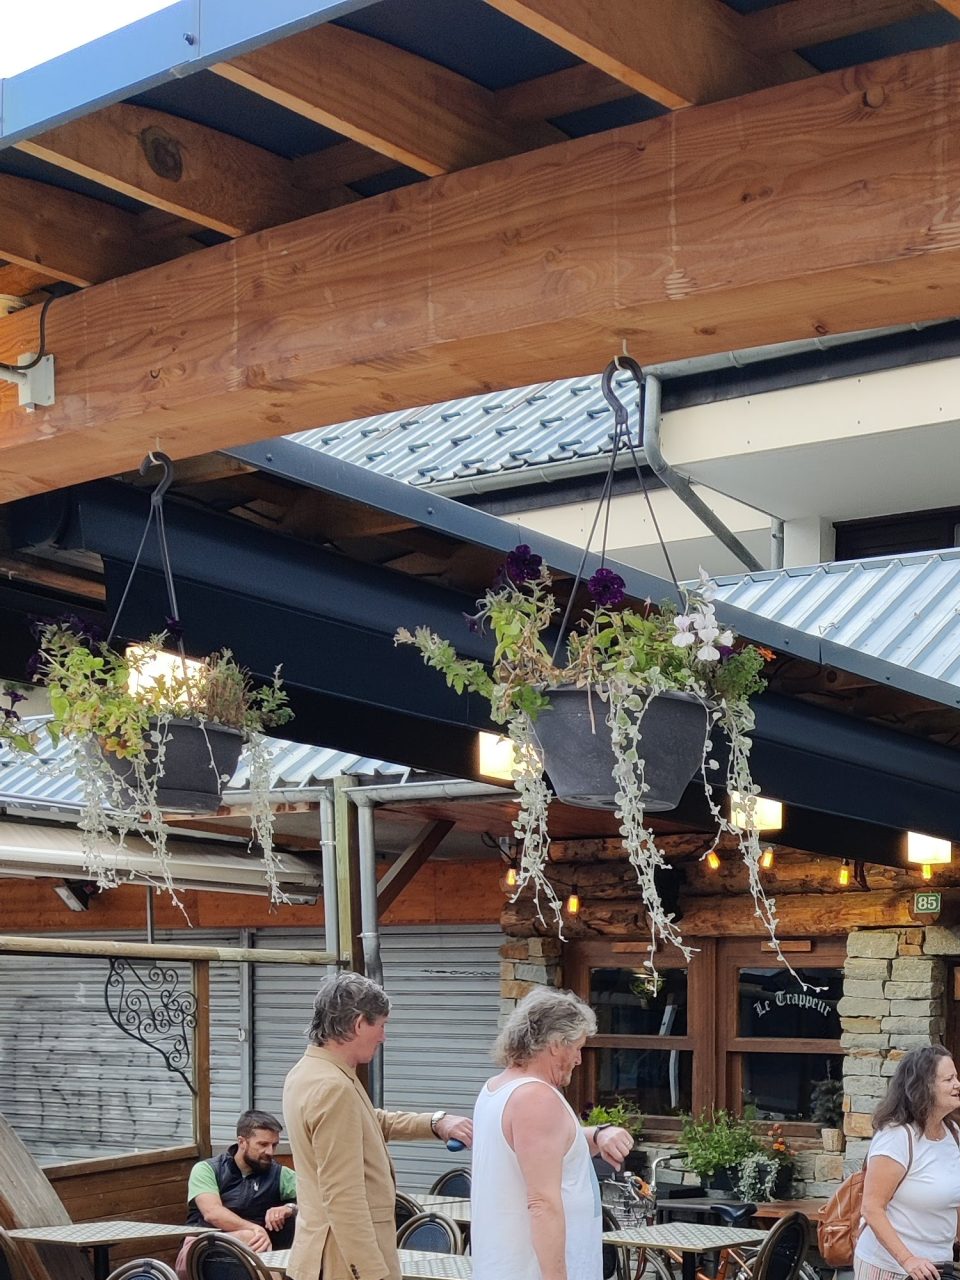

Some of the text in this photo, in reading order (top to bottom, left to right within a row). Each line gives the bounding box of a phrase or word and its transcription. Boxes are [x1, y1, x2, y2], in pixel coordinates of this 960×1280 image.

[917, 895, 938, 911] 85
[753, 989, 832, 1018] Le Trappeur
